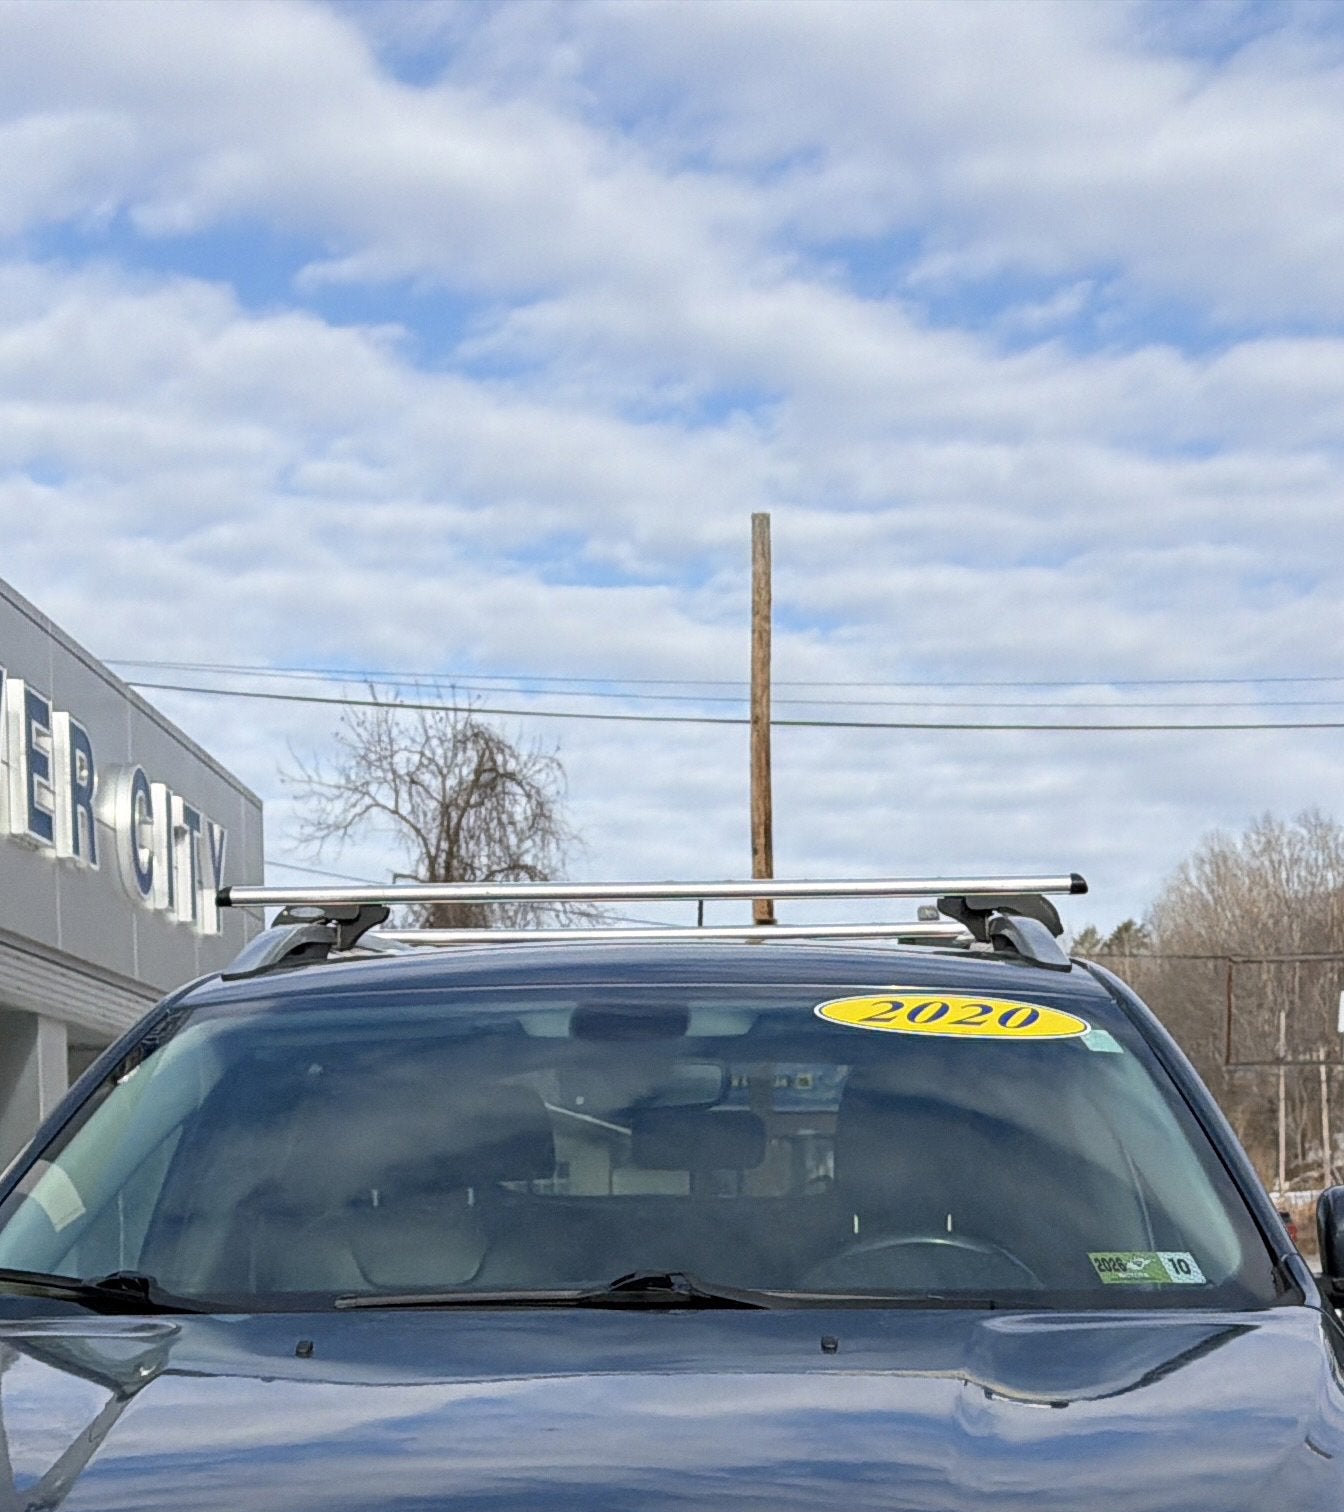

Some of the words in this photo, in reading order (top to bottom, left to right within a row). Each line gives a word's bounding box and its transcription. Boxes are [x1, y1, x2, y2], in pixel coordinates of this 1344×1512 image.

[115, 763, 228, 936] CITY
[859, 1000, 1040, 1029] 2020
[1167, 1257, 1192, 1276] 10
